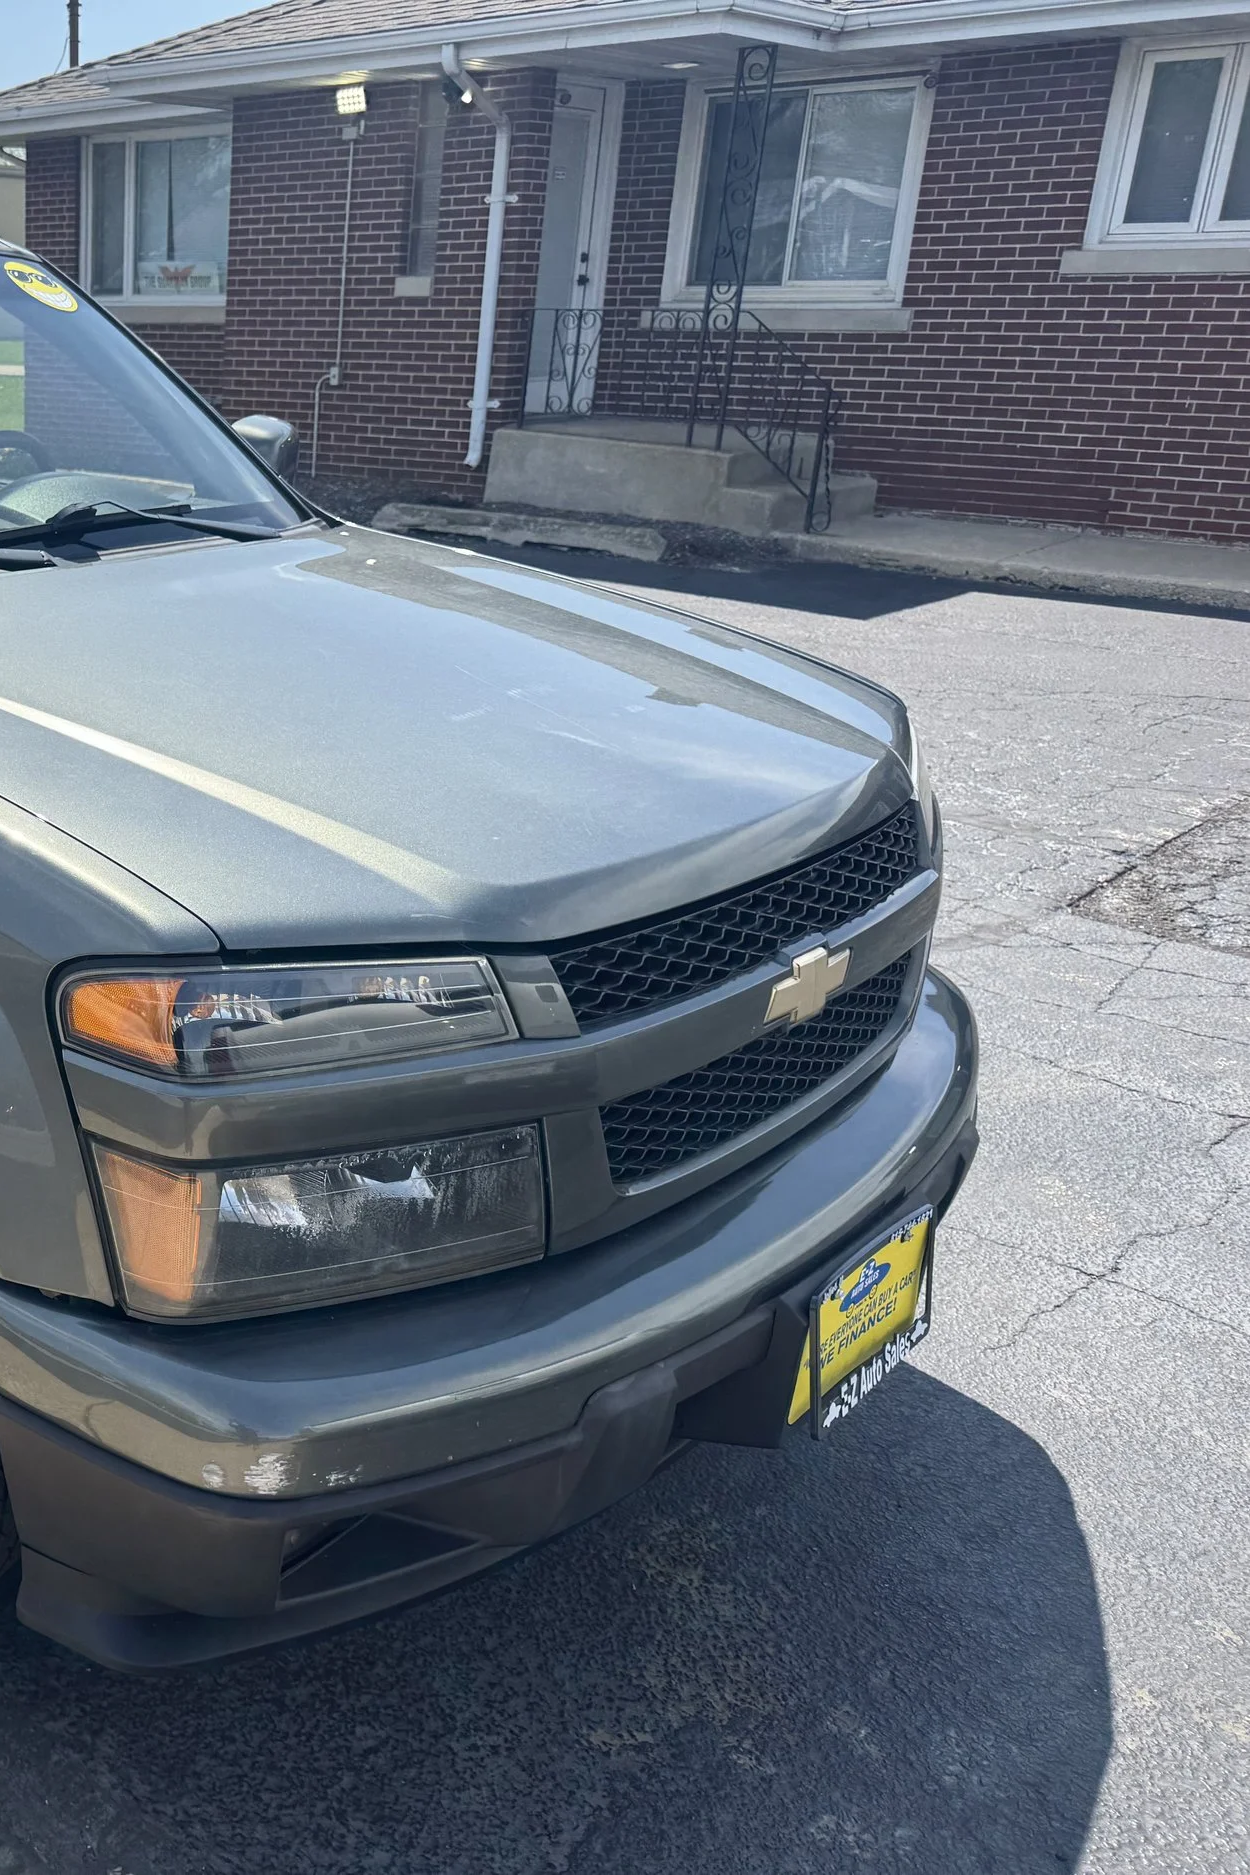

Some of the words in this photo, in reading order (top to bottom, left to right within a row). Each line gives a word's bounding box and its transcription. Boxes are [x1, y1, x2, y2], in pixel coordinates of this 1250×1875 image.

[829, 1308, 863, 1347] EVERYONE
[863, 1301, 876, 1317] CAN
[878, 1287, 892, 1307] BUY
[893, 1285, 898, 1296] A
[837, 1297, 898, 1355] FINANCE!
[860, 1357, 882, 1399] Auto
[884, 1332, 911, 1374] Sales
